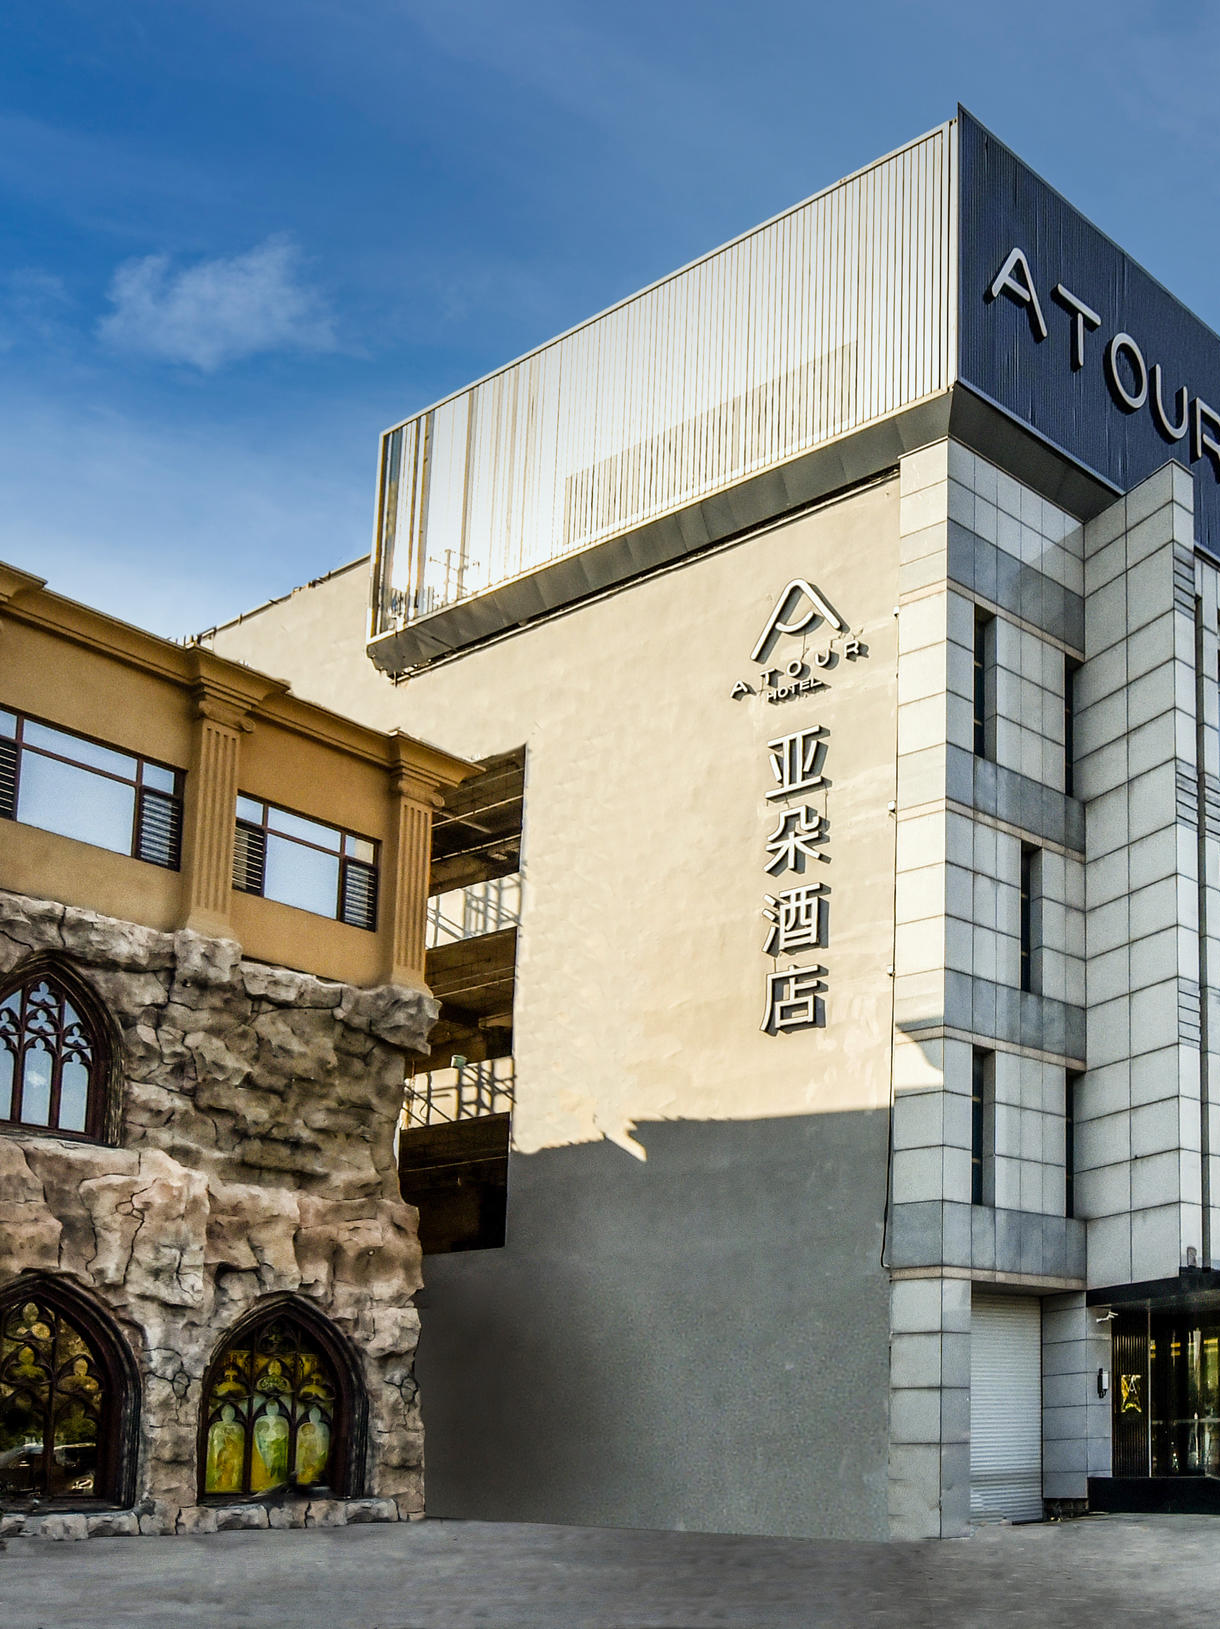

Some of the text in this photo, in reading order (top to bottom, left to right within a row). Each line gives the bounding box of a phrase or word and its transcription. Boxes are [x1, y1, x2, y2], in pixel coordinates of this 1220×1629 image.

[729, 639, 861, 699] ATOUR
[765, 677, 823, 700] HOTEL
[760, 724, 825, 1034] 亚朵酒店
